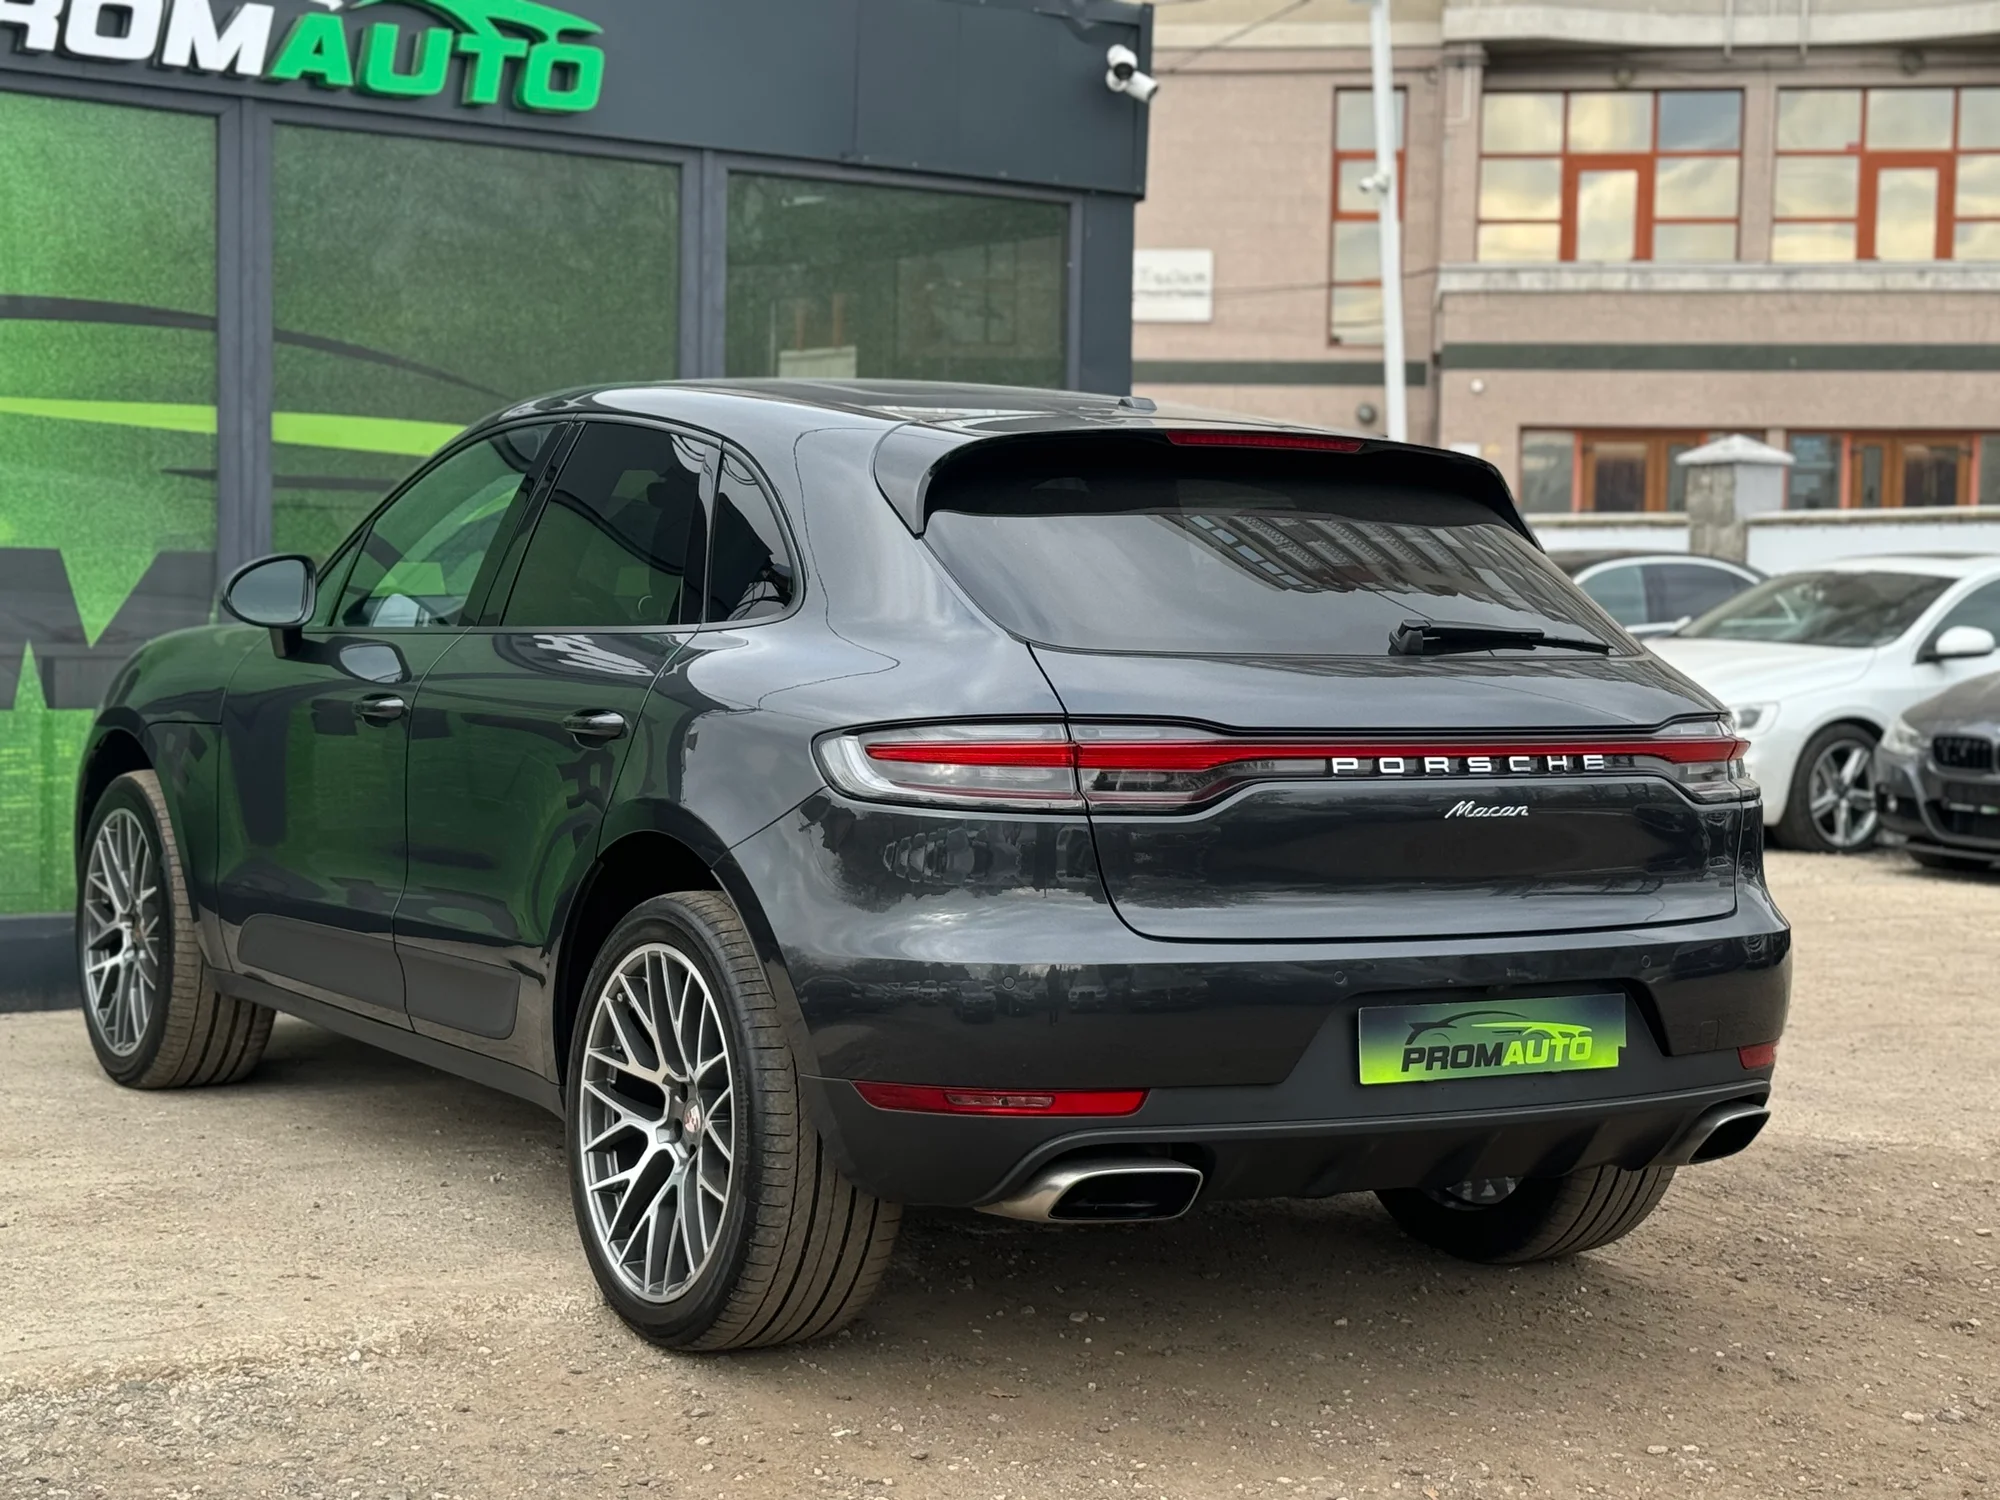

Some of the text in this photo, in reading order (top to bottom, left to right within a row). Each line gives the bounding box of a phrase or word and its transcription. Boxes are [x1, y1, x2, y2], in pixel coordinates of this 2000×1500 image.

[0, 0, 605, 112] ROMAUTO
[1332, 754, 1605, 774] PORSCHE
[1444, 800, 1529, 819] Macan
[1401, 1036, 1593, 1072] PROMAUTO
